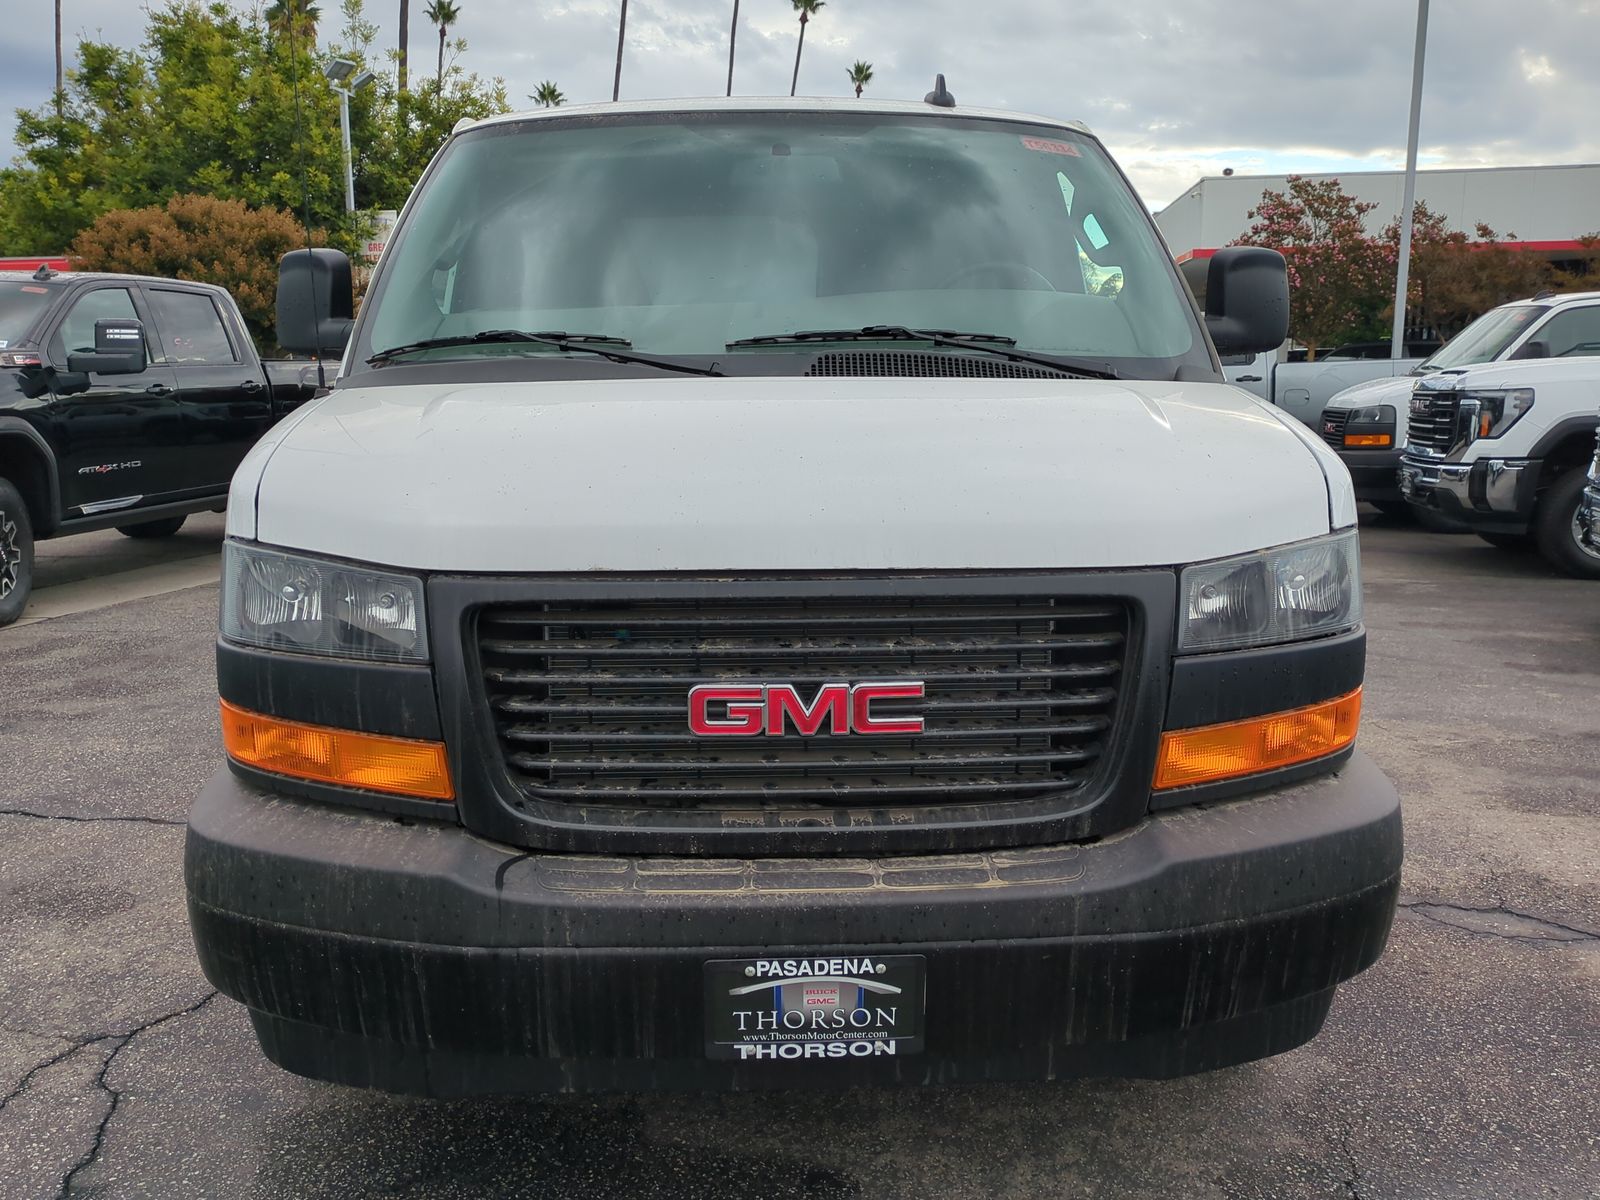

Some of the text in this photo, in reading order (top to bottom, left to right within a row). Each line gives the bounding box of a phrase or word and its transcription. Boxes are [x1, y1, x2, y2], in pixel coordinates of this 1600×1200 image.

[688, 682, 925, 736] GMC
[756, 958, 875, 977] PASADENA
[732, 1007, 897, 1031] THORSON
[743, 1030, 888, 1042] www.ThorsonMotorCenter.com
[733, 1040, 896, 1060] THORSON
